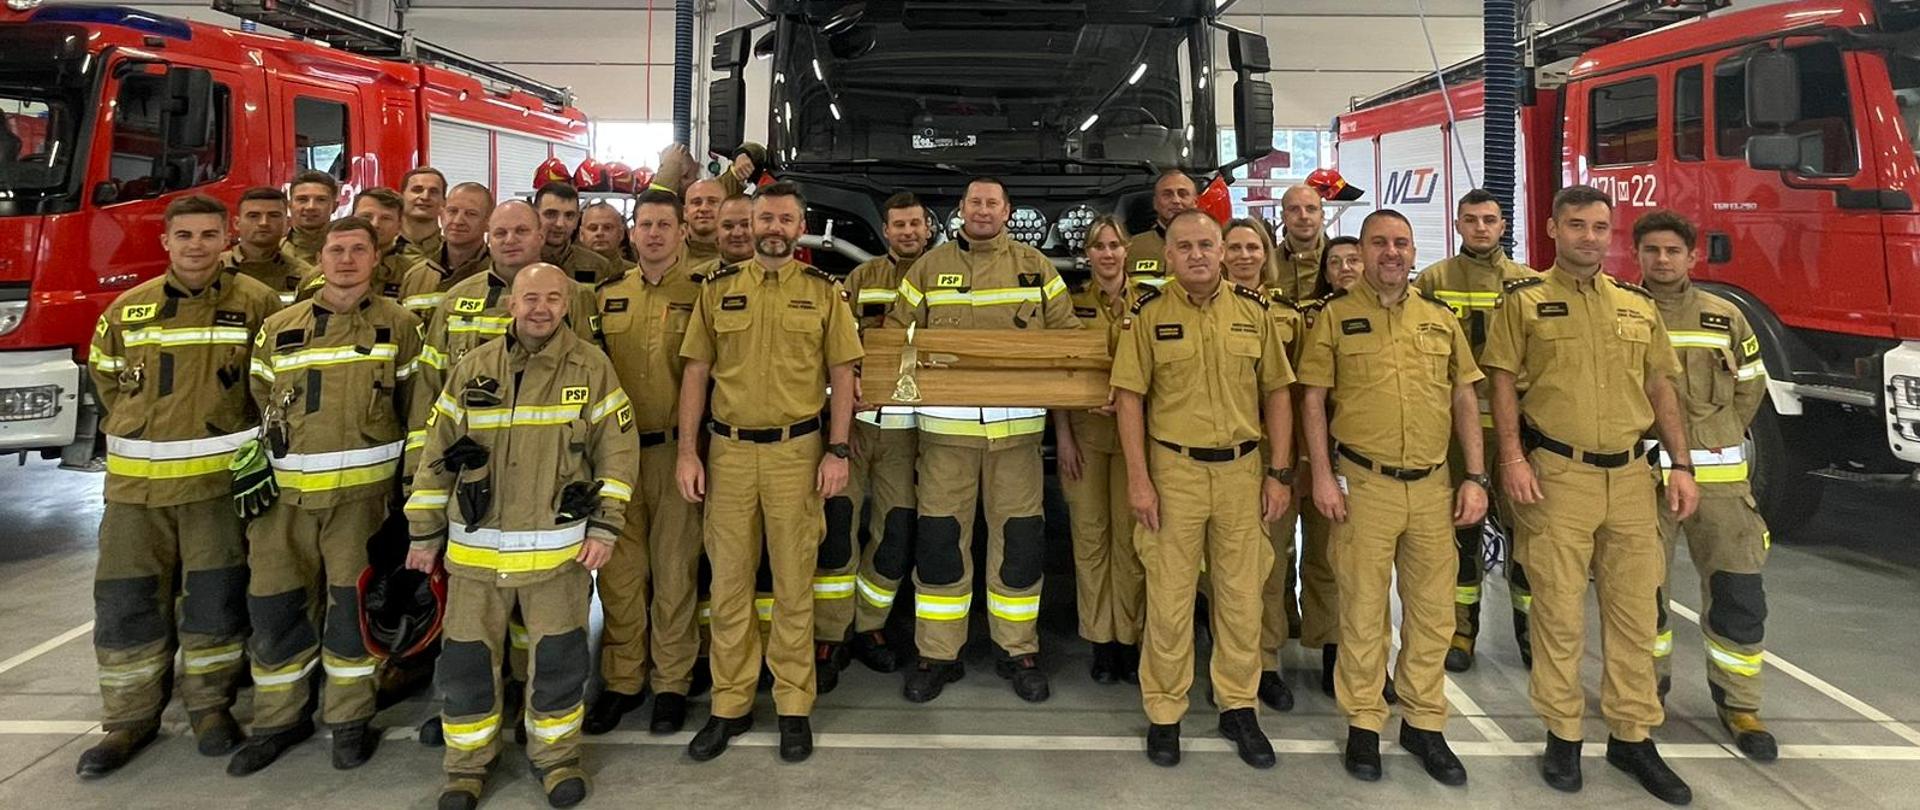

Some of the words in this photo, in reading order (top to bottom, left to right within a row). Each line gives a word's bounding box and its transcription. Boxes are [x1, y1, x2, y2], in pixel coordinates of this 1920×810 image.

[1631, 174, 1657, 207] 22
[941, 275, 960, 285] PSP
[459, 300, 481, 310] PSP
[566, 389, 587, 401] PSP
